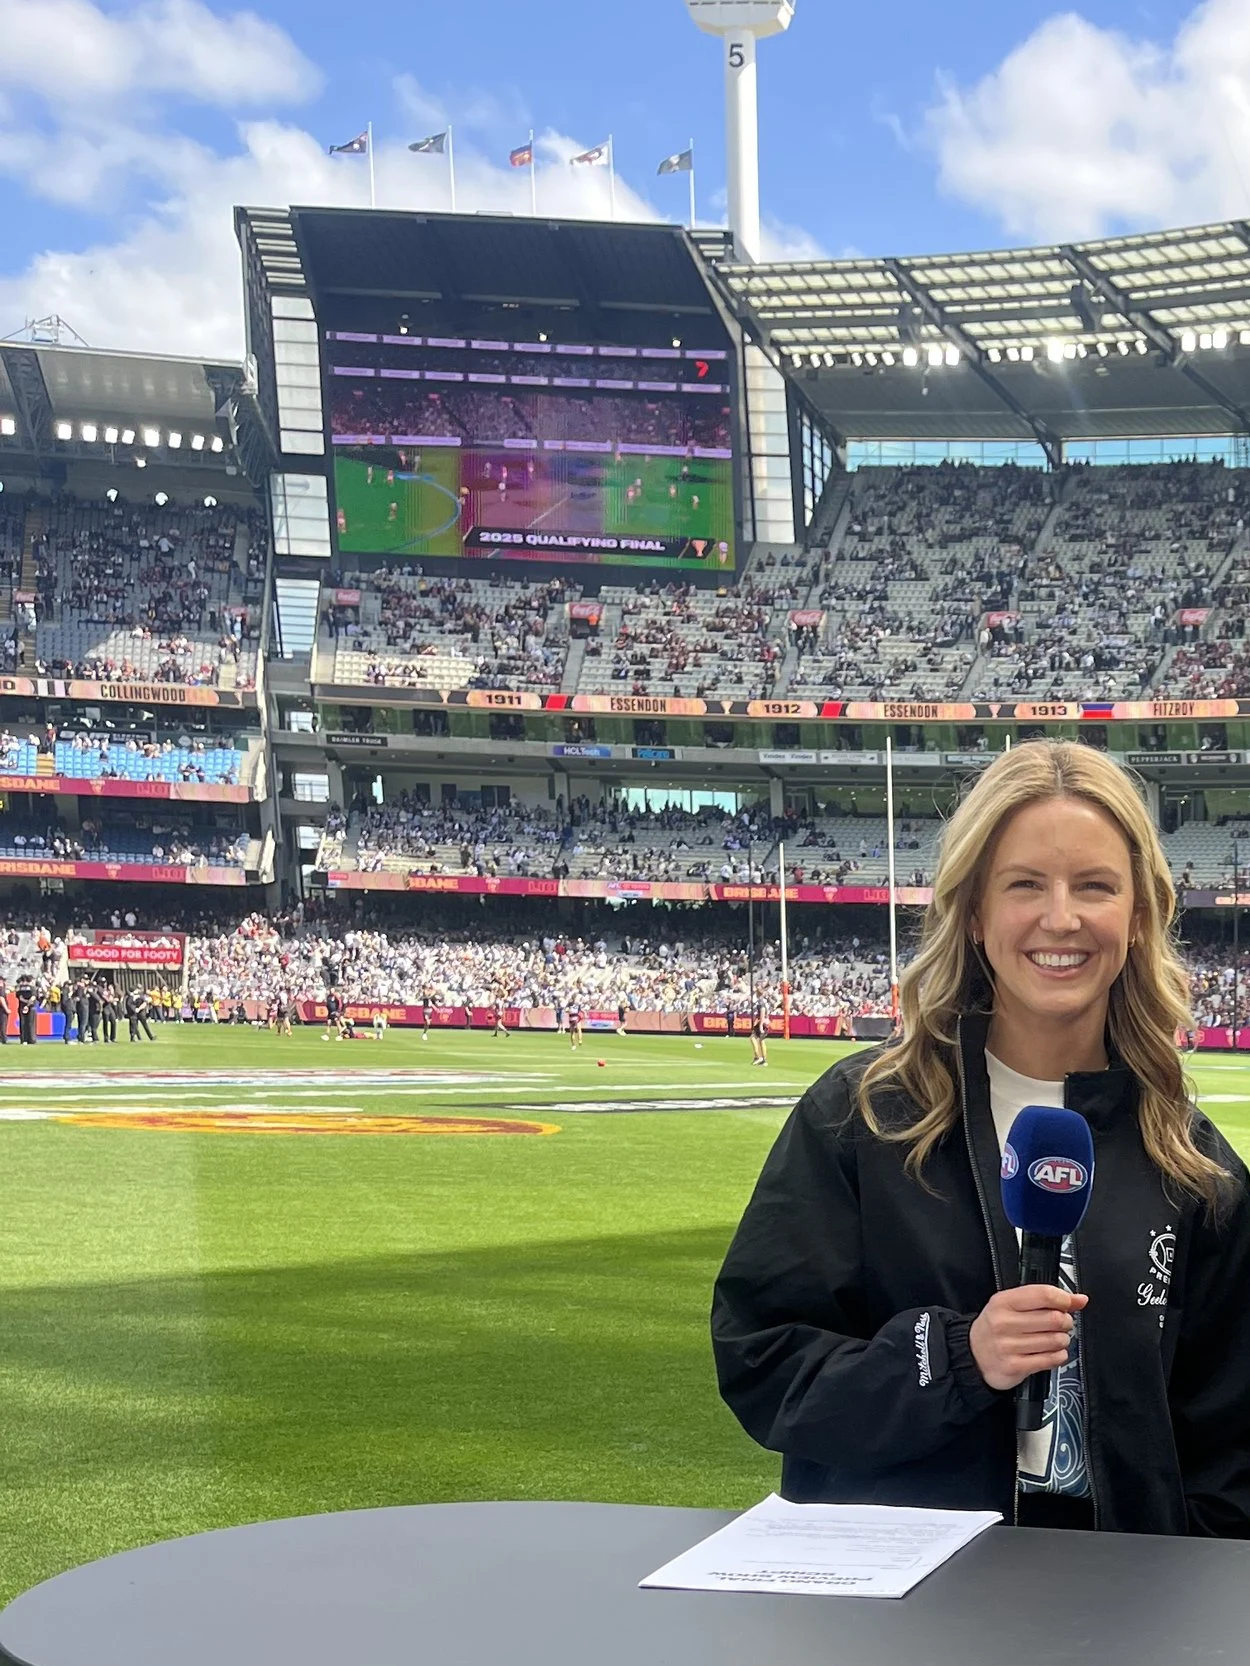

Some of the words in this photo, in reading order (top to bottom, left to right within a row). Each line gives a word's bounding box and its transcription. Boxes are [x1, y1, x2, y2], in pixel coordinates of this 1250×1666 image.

[729, 43, 744, 68] 5
[480, 531, 523, 543] 2025
[526, 534, 617, 549] QUALIFYING
[620, 539, 665, 551] FINAL
[101, 684, 186, 702] COLLINGWOOD
[486, 693, 523, 705] 1911
[610, 697, 666, 713] ESSENDON
[764, 703, 801, 714] 1912
[883, 704, 938, 718] ESSENDON
[1030, 705, 1068, 716] 1913
[1153, 701, 1196, 716] FITZROY
[86, 948, 119, 958] GOOD
[121, 950, 141, 959] FOR
[144, 951, 178, 960] FOOTY
[1034, 1164, 1082, 1185] AFL
[914, 1340, 930, 1387] Mitchell
